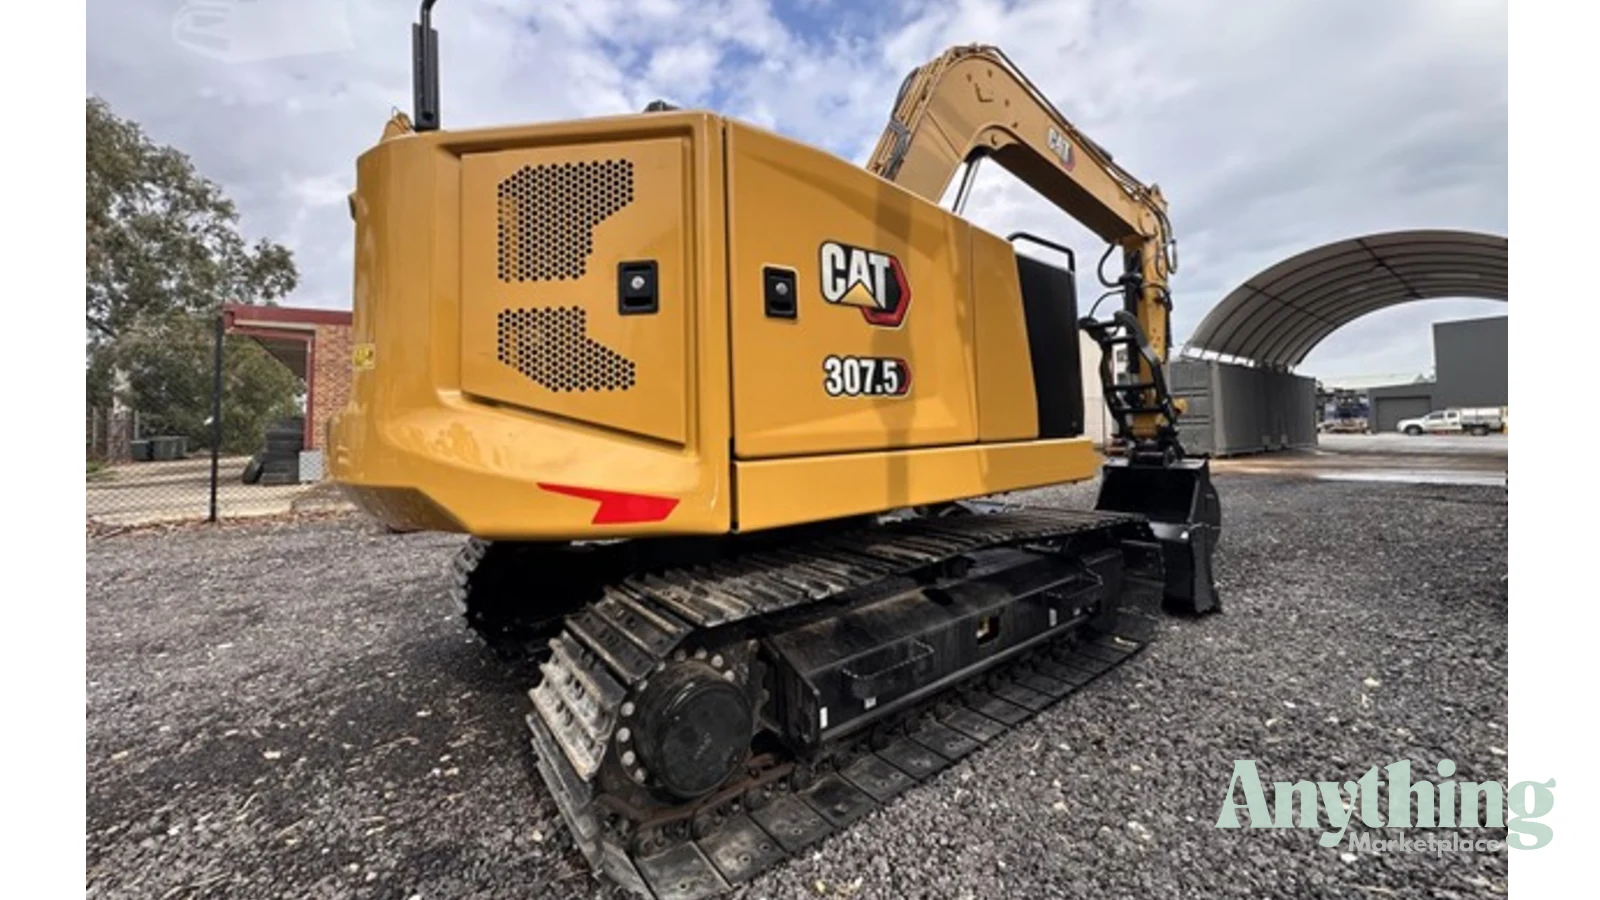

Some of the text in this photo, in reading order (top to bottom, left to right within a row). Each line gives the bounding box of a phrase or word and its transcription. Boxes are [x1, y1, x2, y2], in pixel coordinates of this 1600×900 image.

[1048, 127, 1071, 163] CAT
[821, 242, 890, 309] CAT
[824, 356, 898, 395] 307.5
